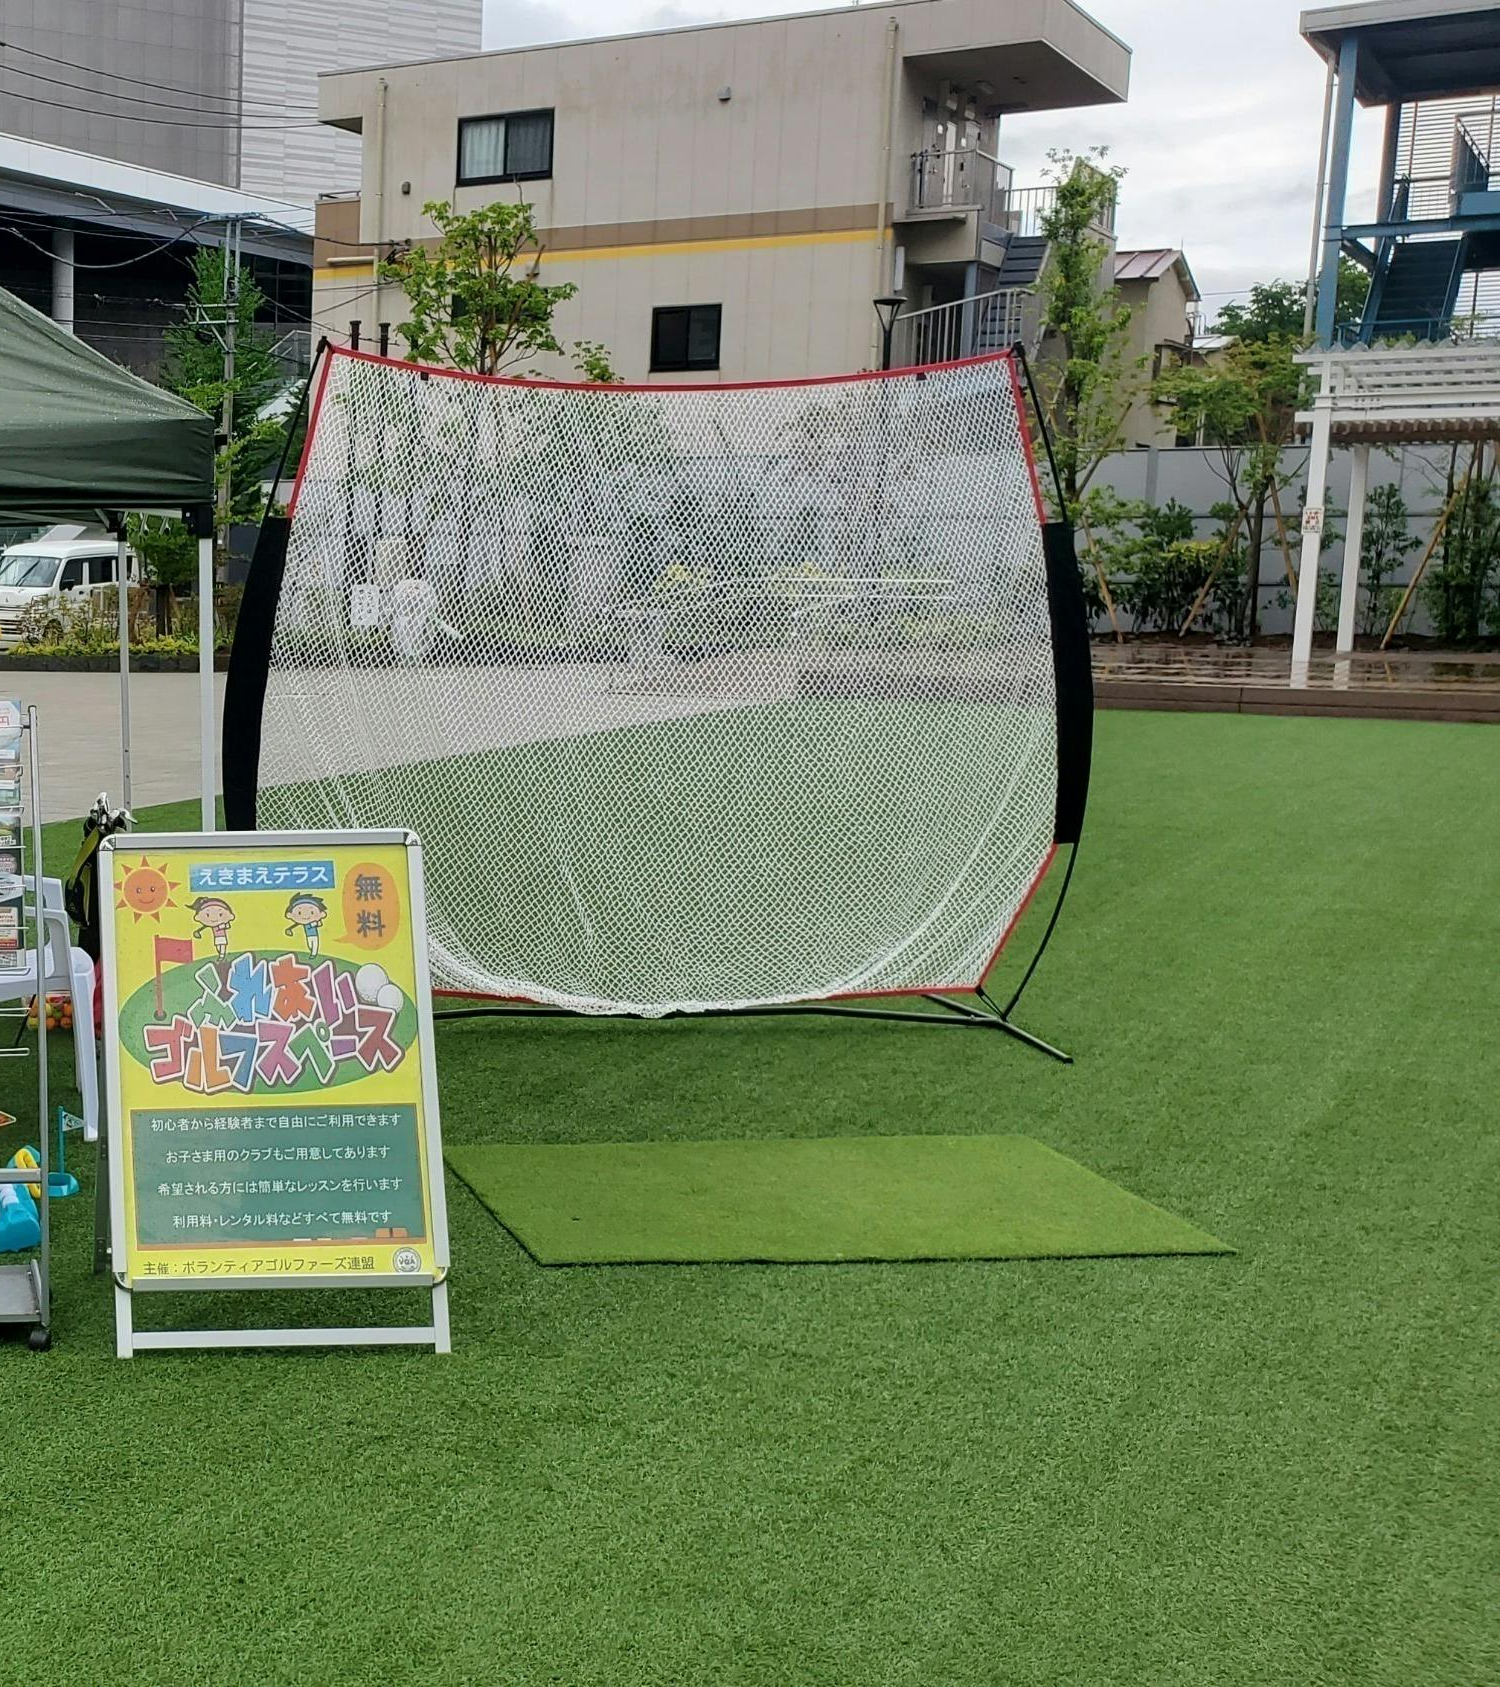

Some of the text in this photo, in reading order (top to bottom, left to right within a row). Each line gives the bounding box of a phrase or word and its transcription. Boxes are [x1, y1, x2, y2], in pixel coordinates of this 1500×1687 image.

[199, 866, 329, 886] えきまえテラス
[354, 873, 386, 938] 無料
[187, 952, 358, 1031] ふれあい
[144, 1004, 402, 1094] ゴルフスペース
[150, 1113, 402, 1132] 初心者から経験者まで自由にご利用できます
[165, 1145, 391, 1164] お子さま用のクラブもご用意してあります
[157, 1177, 403, 1196] 希望される方には簡単なレッスンを行います
[172, 1209, 392, 1229] 利用料・レンタル料などすべて無料です
